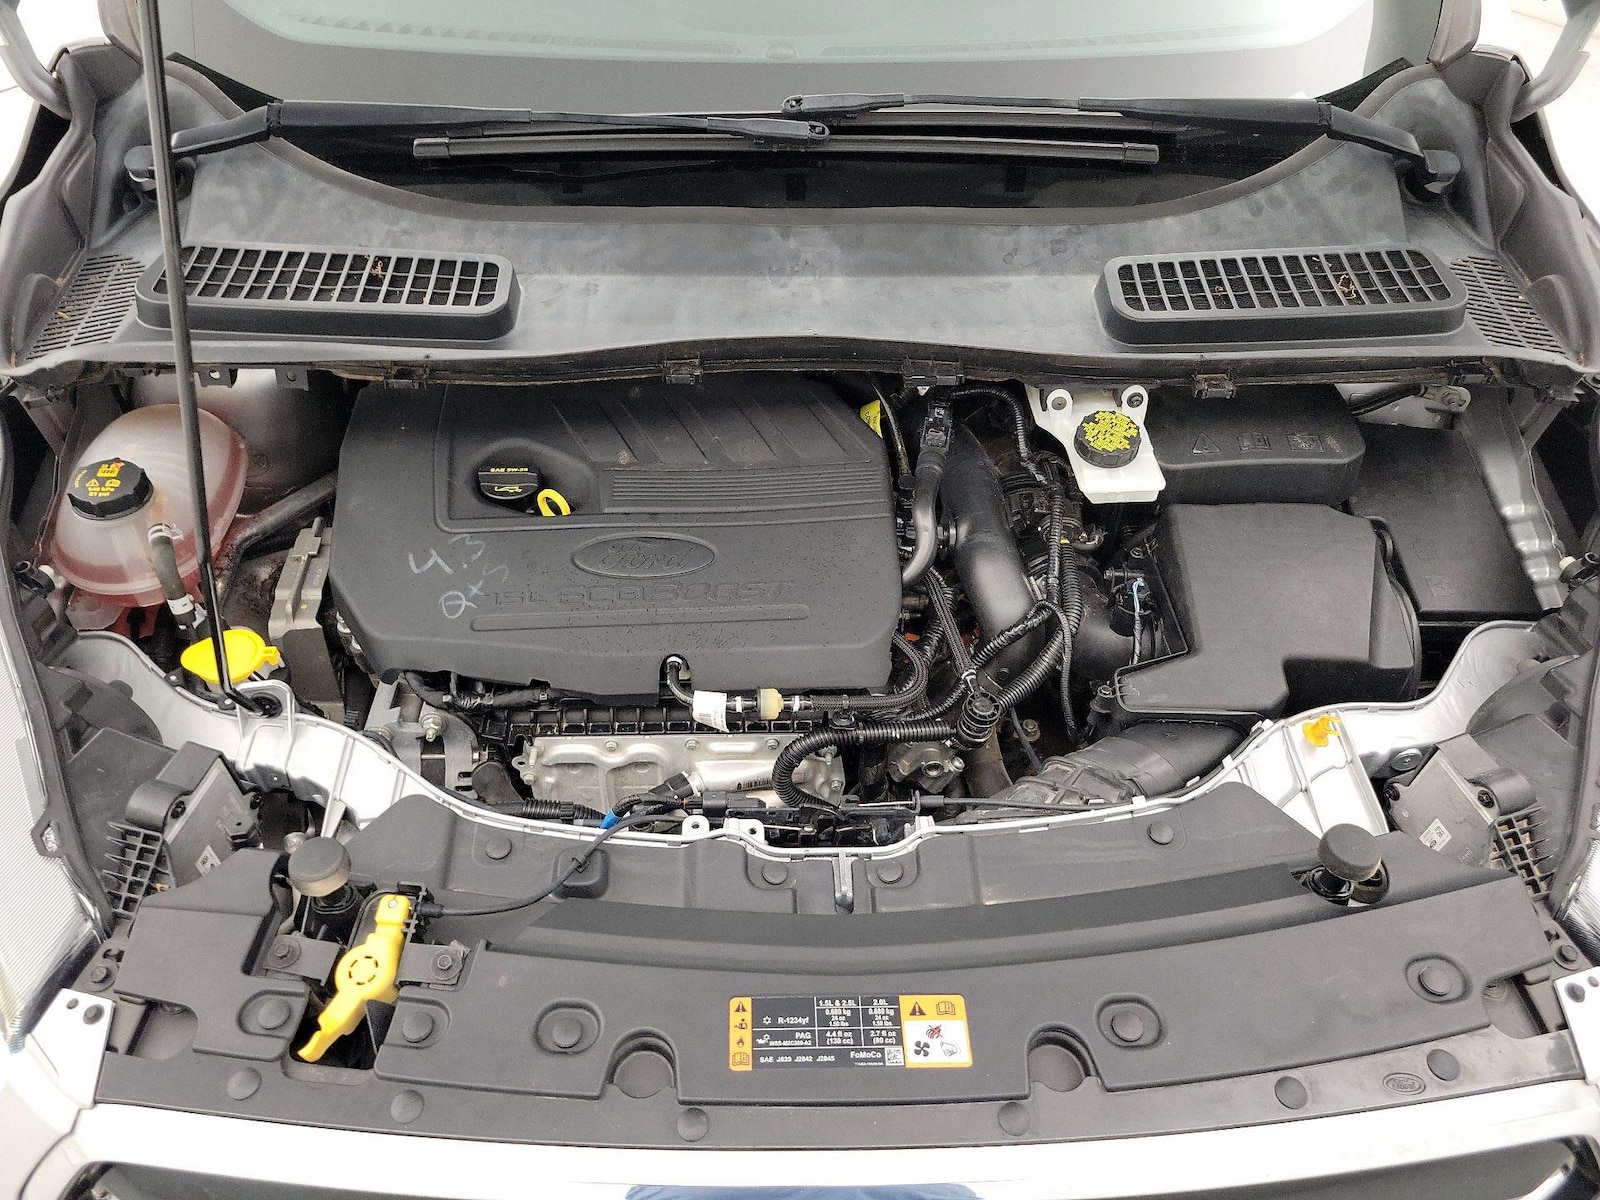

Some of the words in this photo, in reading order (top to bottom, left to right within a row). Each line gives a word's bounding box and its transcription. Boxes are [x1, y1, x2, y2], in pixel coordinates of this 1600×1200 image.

[601, 542, 694, 570] Ford
[557, 579, 795, 605] ECOBOOST
[819, 999, 834, 1007] 1.5L
[872, 998, 889, 1006] 2.0L
[843, 1008, 851, 1016] kg
[886, 1007, 894, 1016] kg
[777, 1016, 810, 1025] R-1234yf
[795, 1031, 812, 1039] PAG
[826, 1037, 841, 1045] (130
[842, 1037, 854, 1045] cc)
[850, 1051, 882, 1059] FoMoCo
